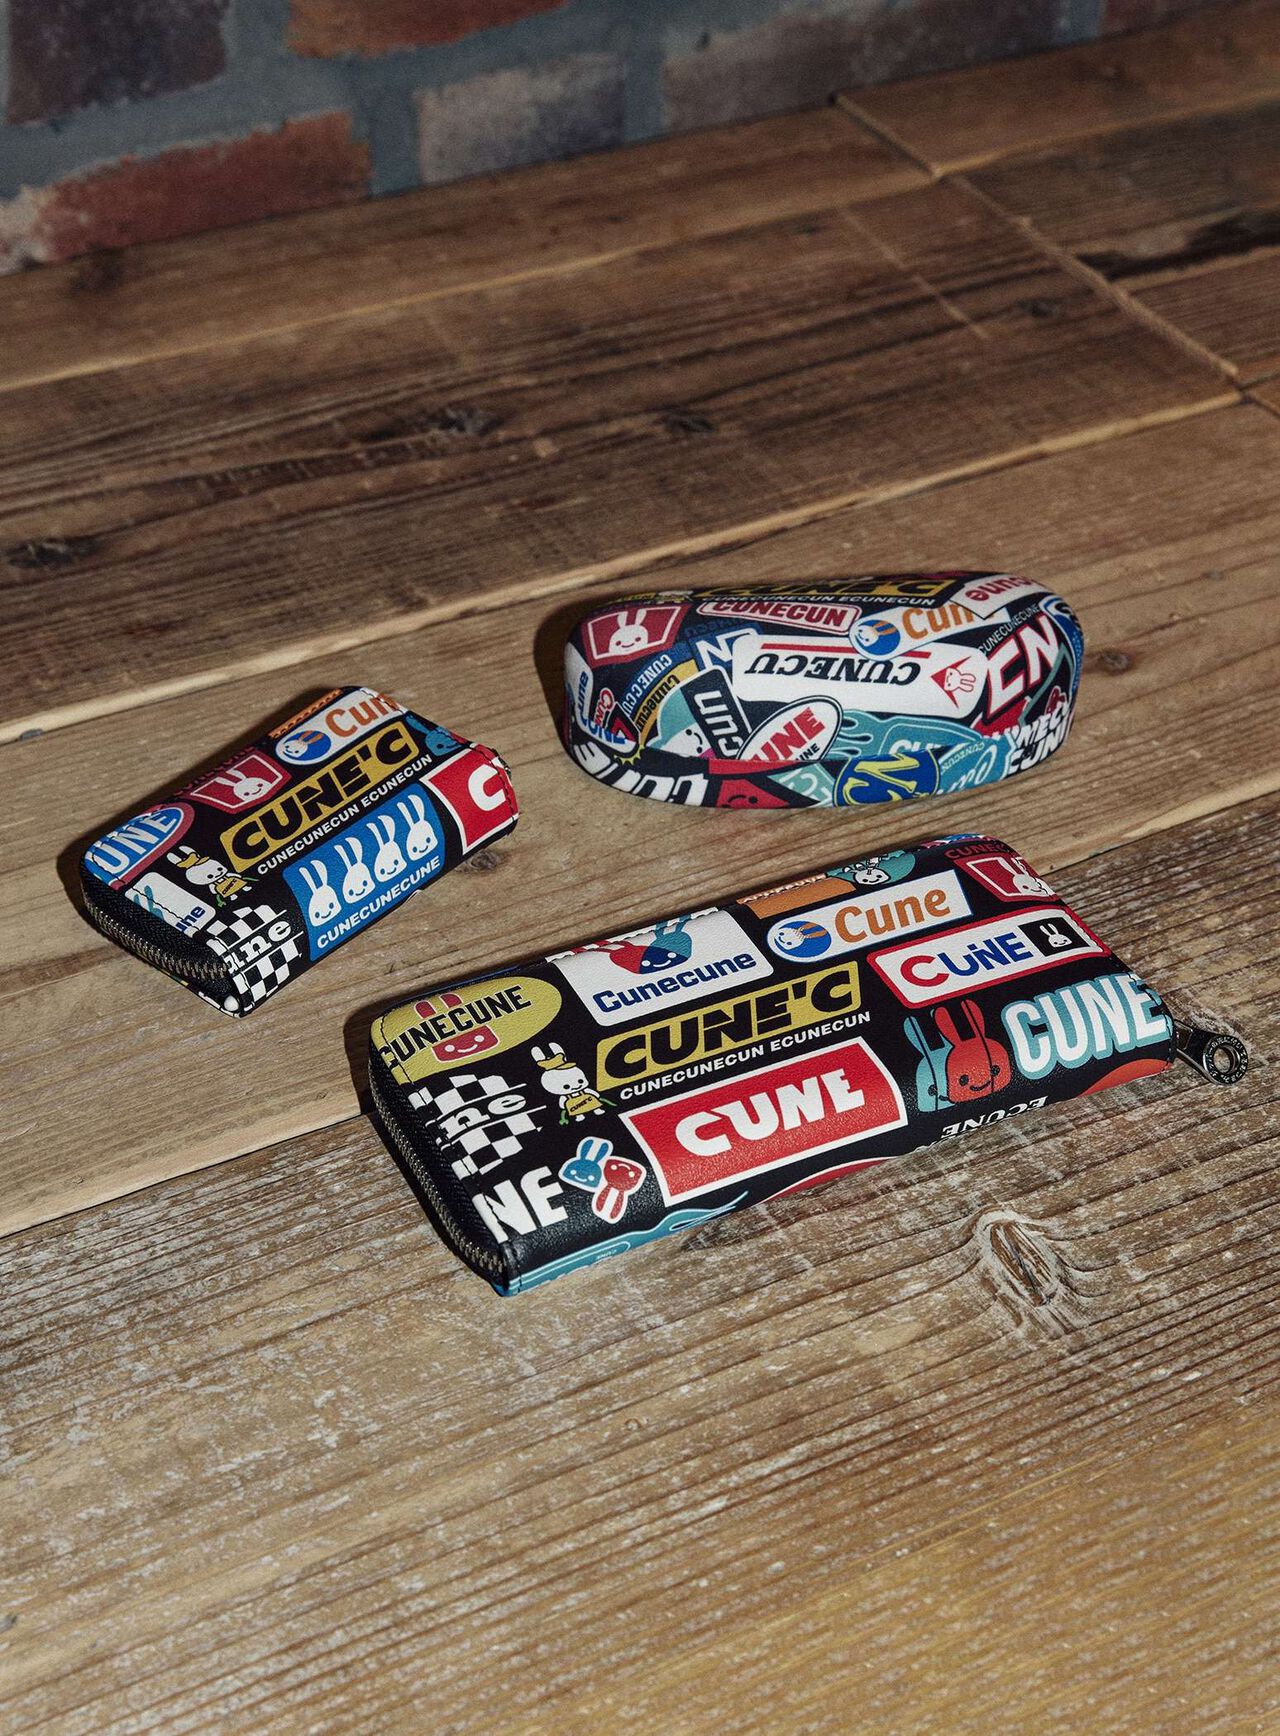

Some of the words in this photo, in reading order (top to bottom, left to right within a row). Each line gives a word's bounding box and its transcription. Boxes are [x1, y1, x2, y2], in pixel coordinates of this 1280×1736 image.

[744, 653, 921, 687] CUNECU
[231, 727, 411, 860] CUNE'C
[257, 803, 359, 875] CUNECUNECUN
[363, 754, 432, 808] ECUNECUN
[316, 856, 440, 950] CUNECUNECUNE
[834, 888, 951, 943] Cune
[592, 953, 757, 1013] Cunecune
[604, 969, 853, 1079] CUNE'C
[1004, 975, 1169, 1077] CUNE
[619, 1045, 765, 1101] CUNECUNECUN
[770, 1011, 872, 1053] ECUNECUN
[675, 1068, 866, 1157] CUNE
